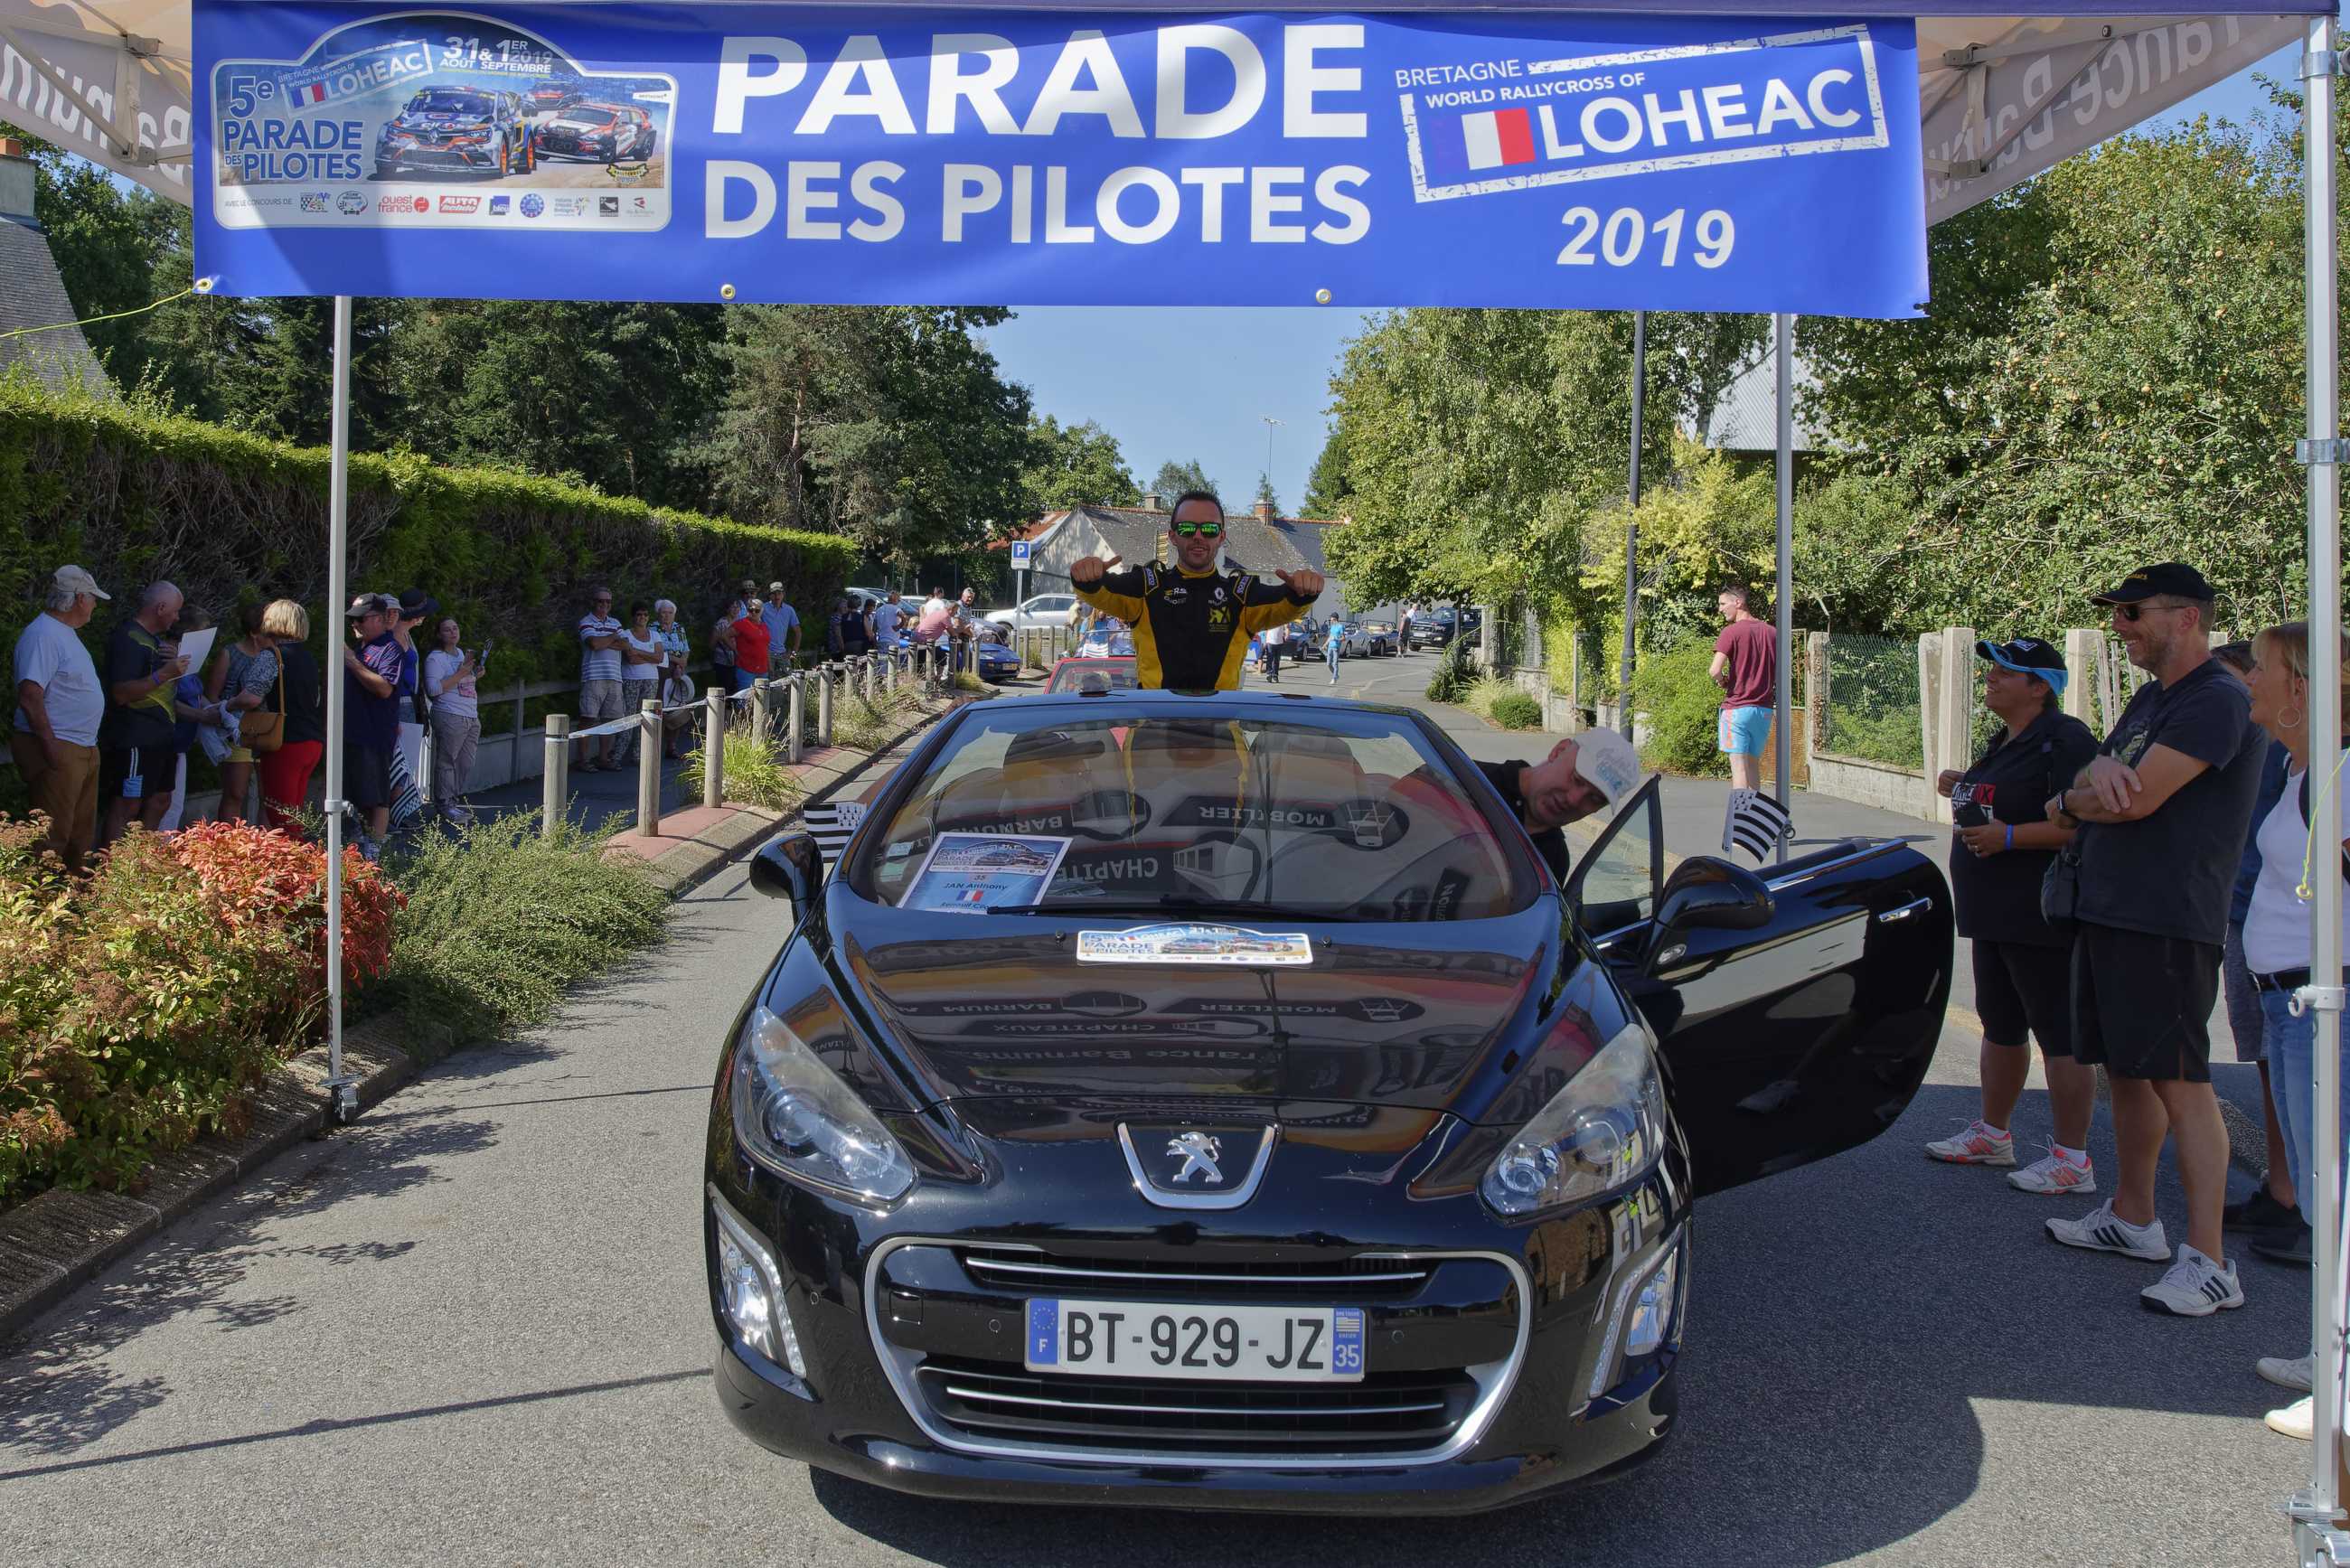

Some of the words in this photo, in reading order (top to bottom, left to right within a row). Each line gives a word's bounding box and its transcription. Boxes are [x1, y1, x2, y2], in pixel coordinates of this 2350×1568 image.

[443, 36, 479, 61] 31
[479, 48, 493, 61] &
[509, 50, 552, 64] 2019
[277, 64, 321, 83] BRETAGNE
[324, 52, 424, 99] LOHEAC
[439, 57, 476, 69] AOÛT
[480, 61, 552, 73] SEPTEMBRE
[1395, 59, 1523, 89] BRETAGNE
[287, 78, 312, 89] WORLD
[712, 24, 1368, 139] PARADE
[1424, 87, 1495, 109] WORLD
[1499, 74, 1615, 102] RALLYCROSS
[1620, 71, 1646, 87] OF
[229, 76, 274, 118] 5e
[1537, 69, 1863, 161] LOHEAC
[223, 118, 364, 151] PARADE
[224, 154, 242, 166] DES
[242, 152, 362, 181] PILOTES
[378, 202, 413, 213] france
[382, 195, 413, 204] ouest
[704, 160, 907, 243] DES
[942, 164, 1372, 245] PILOTES
[1556, 206, 1735, 269] 2019
[1016, 543, 1026, 557] P
[1199, 806, 1325, 826] MOBILIER
[1038, 1338, 1048, 1353] F
[1067, 1310, 1324, 1370] BT-929-JZ
[1334, 1344, 1360, 1368] 35
